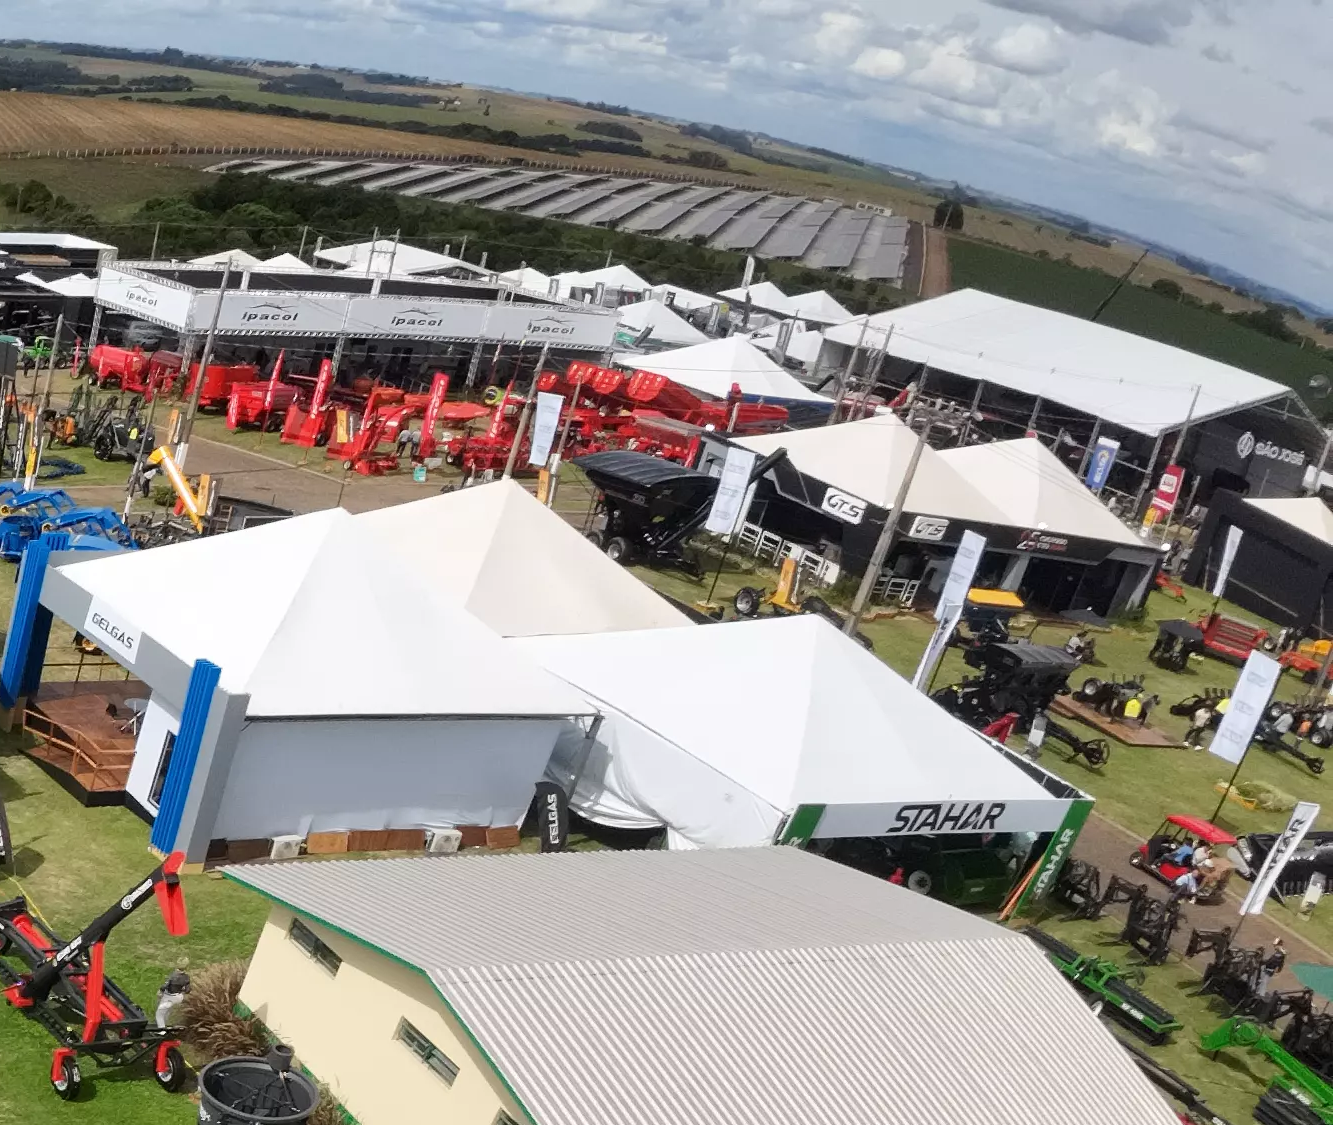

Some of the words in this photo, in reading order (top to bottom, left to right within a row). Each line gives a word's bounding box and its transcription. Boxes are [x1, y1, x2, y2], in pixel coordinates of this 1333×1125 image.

[241, 311, 299, 324] ipacol
[825, 493, 864, 518] GTS
[92, 612, 134, 650] GELGAS
[885, 802, 1007, 834] STAHAR
[1033, 828, 1075, 897] STAHAR
